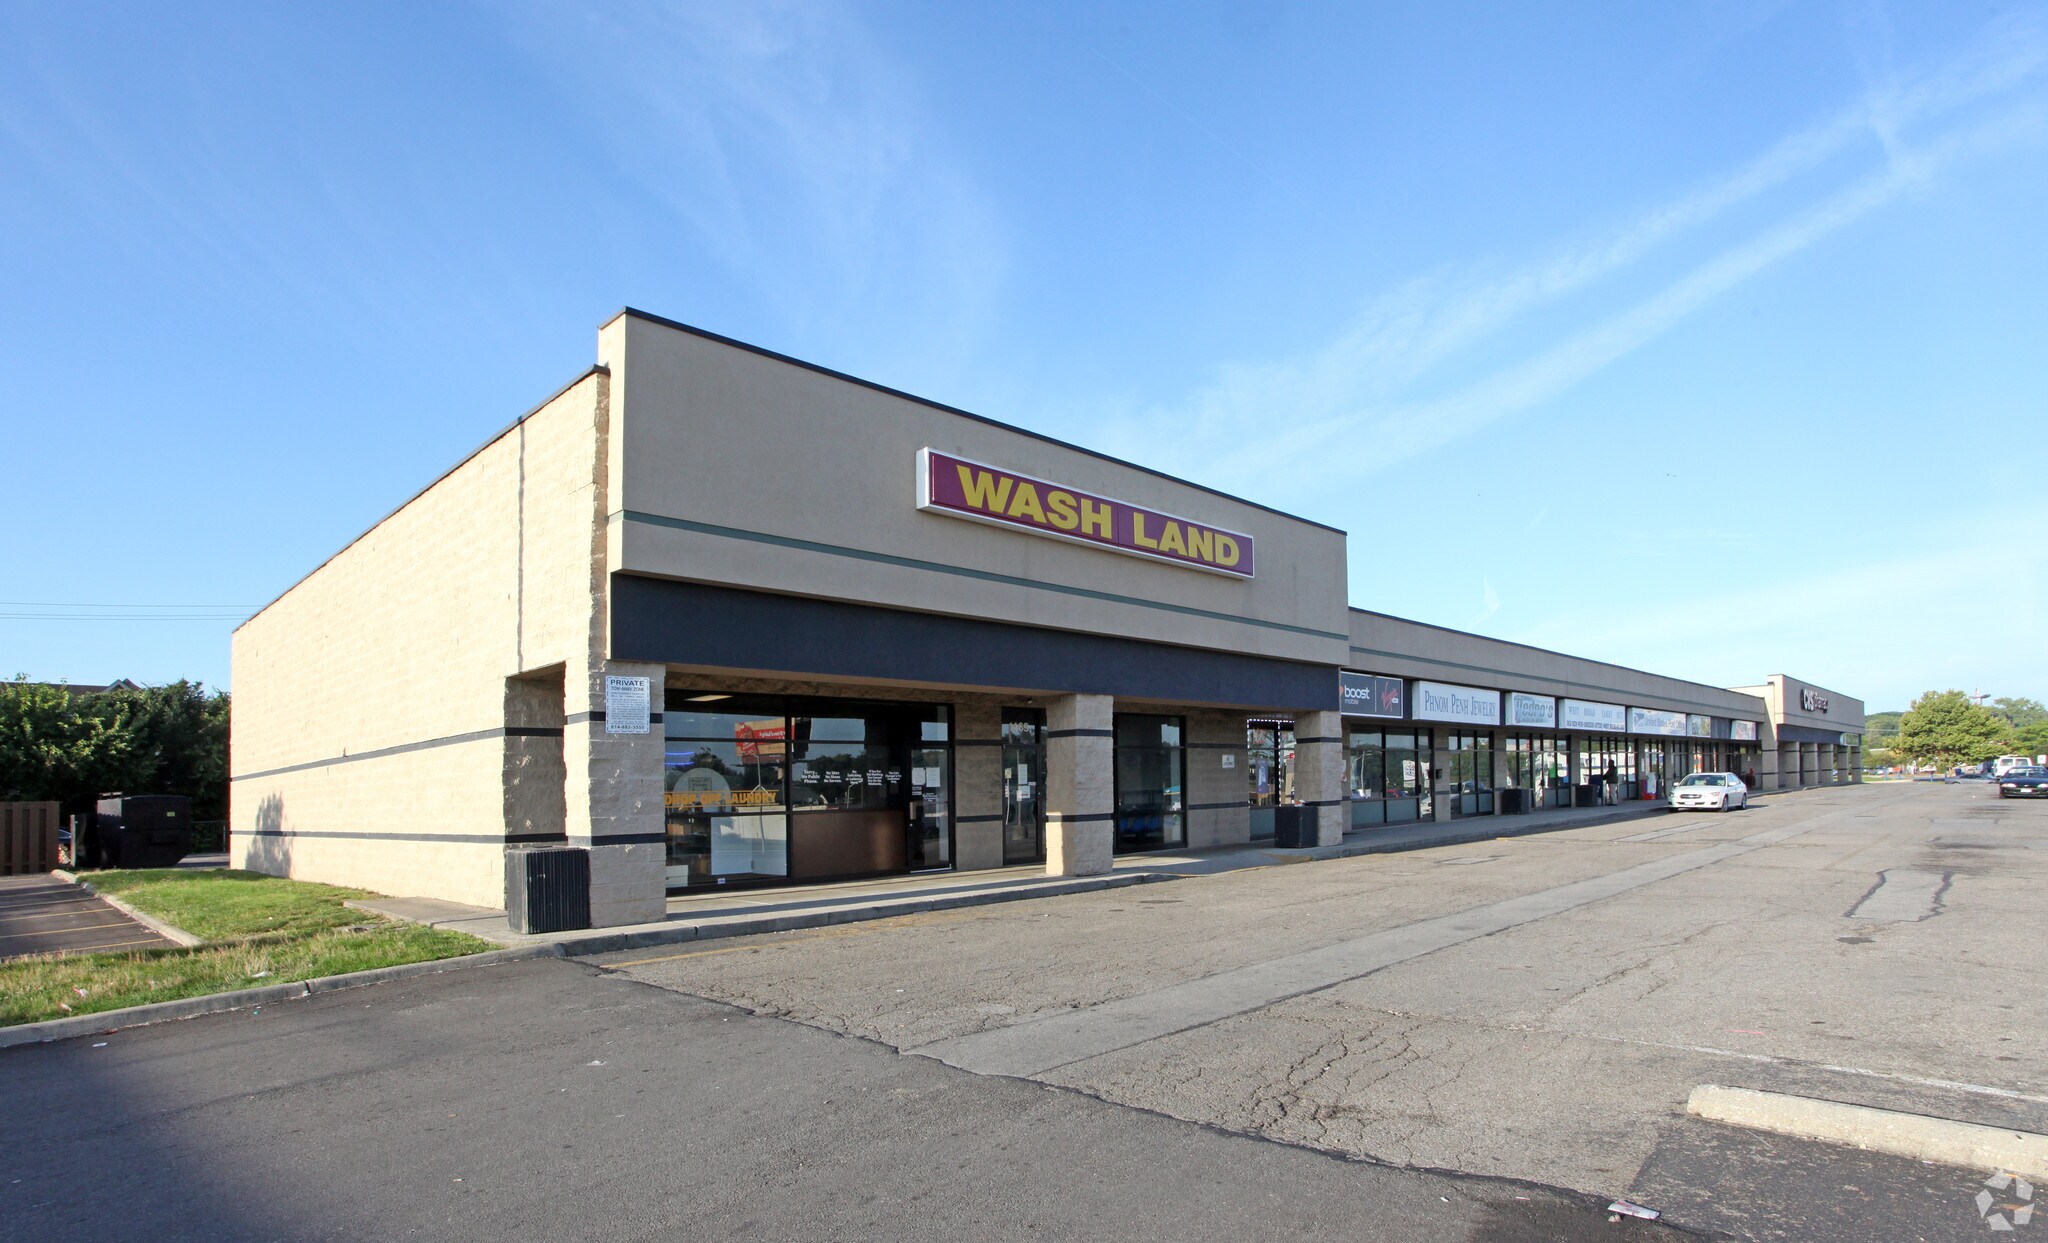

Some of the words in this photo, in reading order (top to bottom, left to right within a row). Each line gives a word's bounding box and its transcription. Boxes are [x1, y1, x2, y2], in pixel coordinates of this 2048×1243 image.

[956, 464, 1112, 539] WASH
[1133, 511, 1240, 567] LAND
[1344, 684, 1370, 699] boost
[724, 793, 776, 803] LAUNDRY
